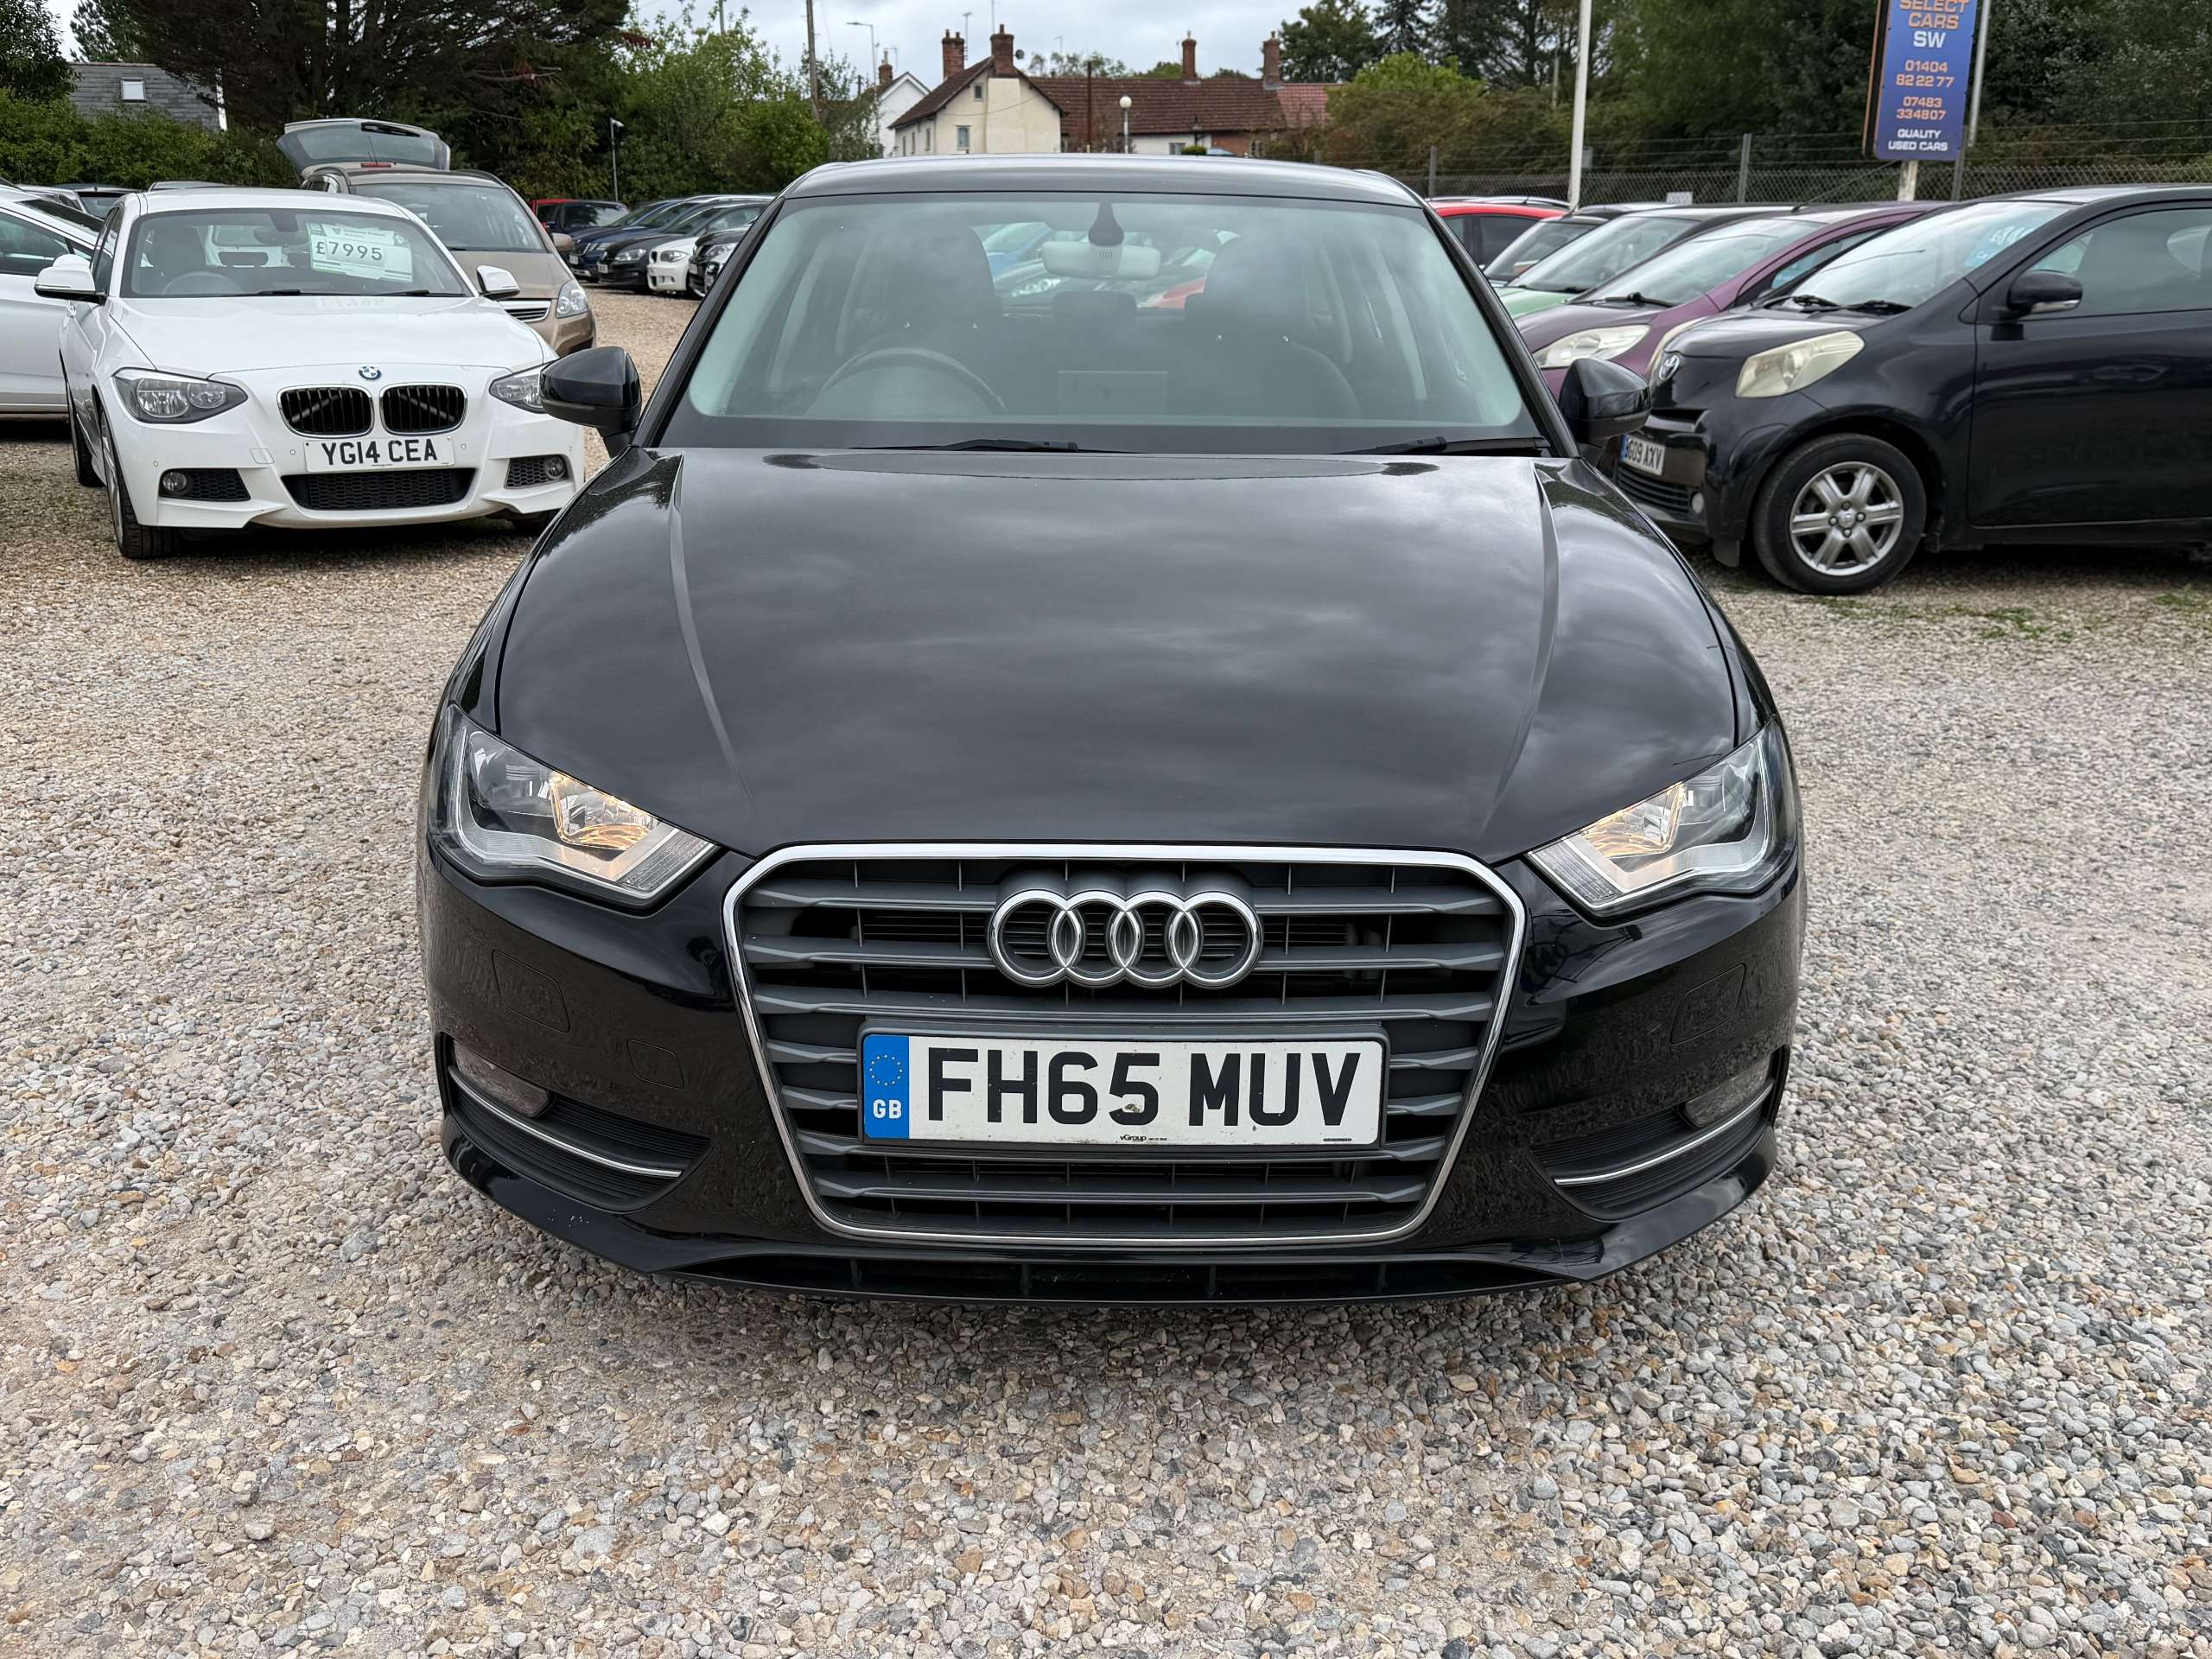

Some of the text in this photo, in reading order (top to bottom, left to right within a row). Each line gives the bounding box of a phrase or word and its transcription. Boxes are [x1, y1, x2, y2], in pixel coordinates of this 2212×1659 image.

[1900, 0, 1968, 13] SELECT
[1909, 13, 1959, 29] CARS
[1913, 30, 1946, 48] SW
[1905, 60, 1948, 73] 01404
[1904, 96, 1942, 108] 07483
[1896, 108, 1946, 120] 334807
[1897, 128, 1942, 139] QUALITY
[1888, 140, 1948, 152] USED CARS
[315, 241, 382, 261] £7995
[321, 438, 437, 466] YG14 CEA
[928, 1046, 1362, 1127] FH65 MUV
[873, 1098, 902, 1119] GB
